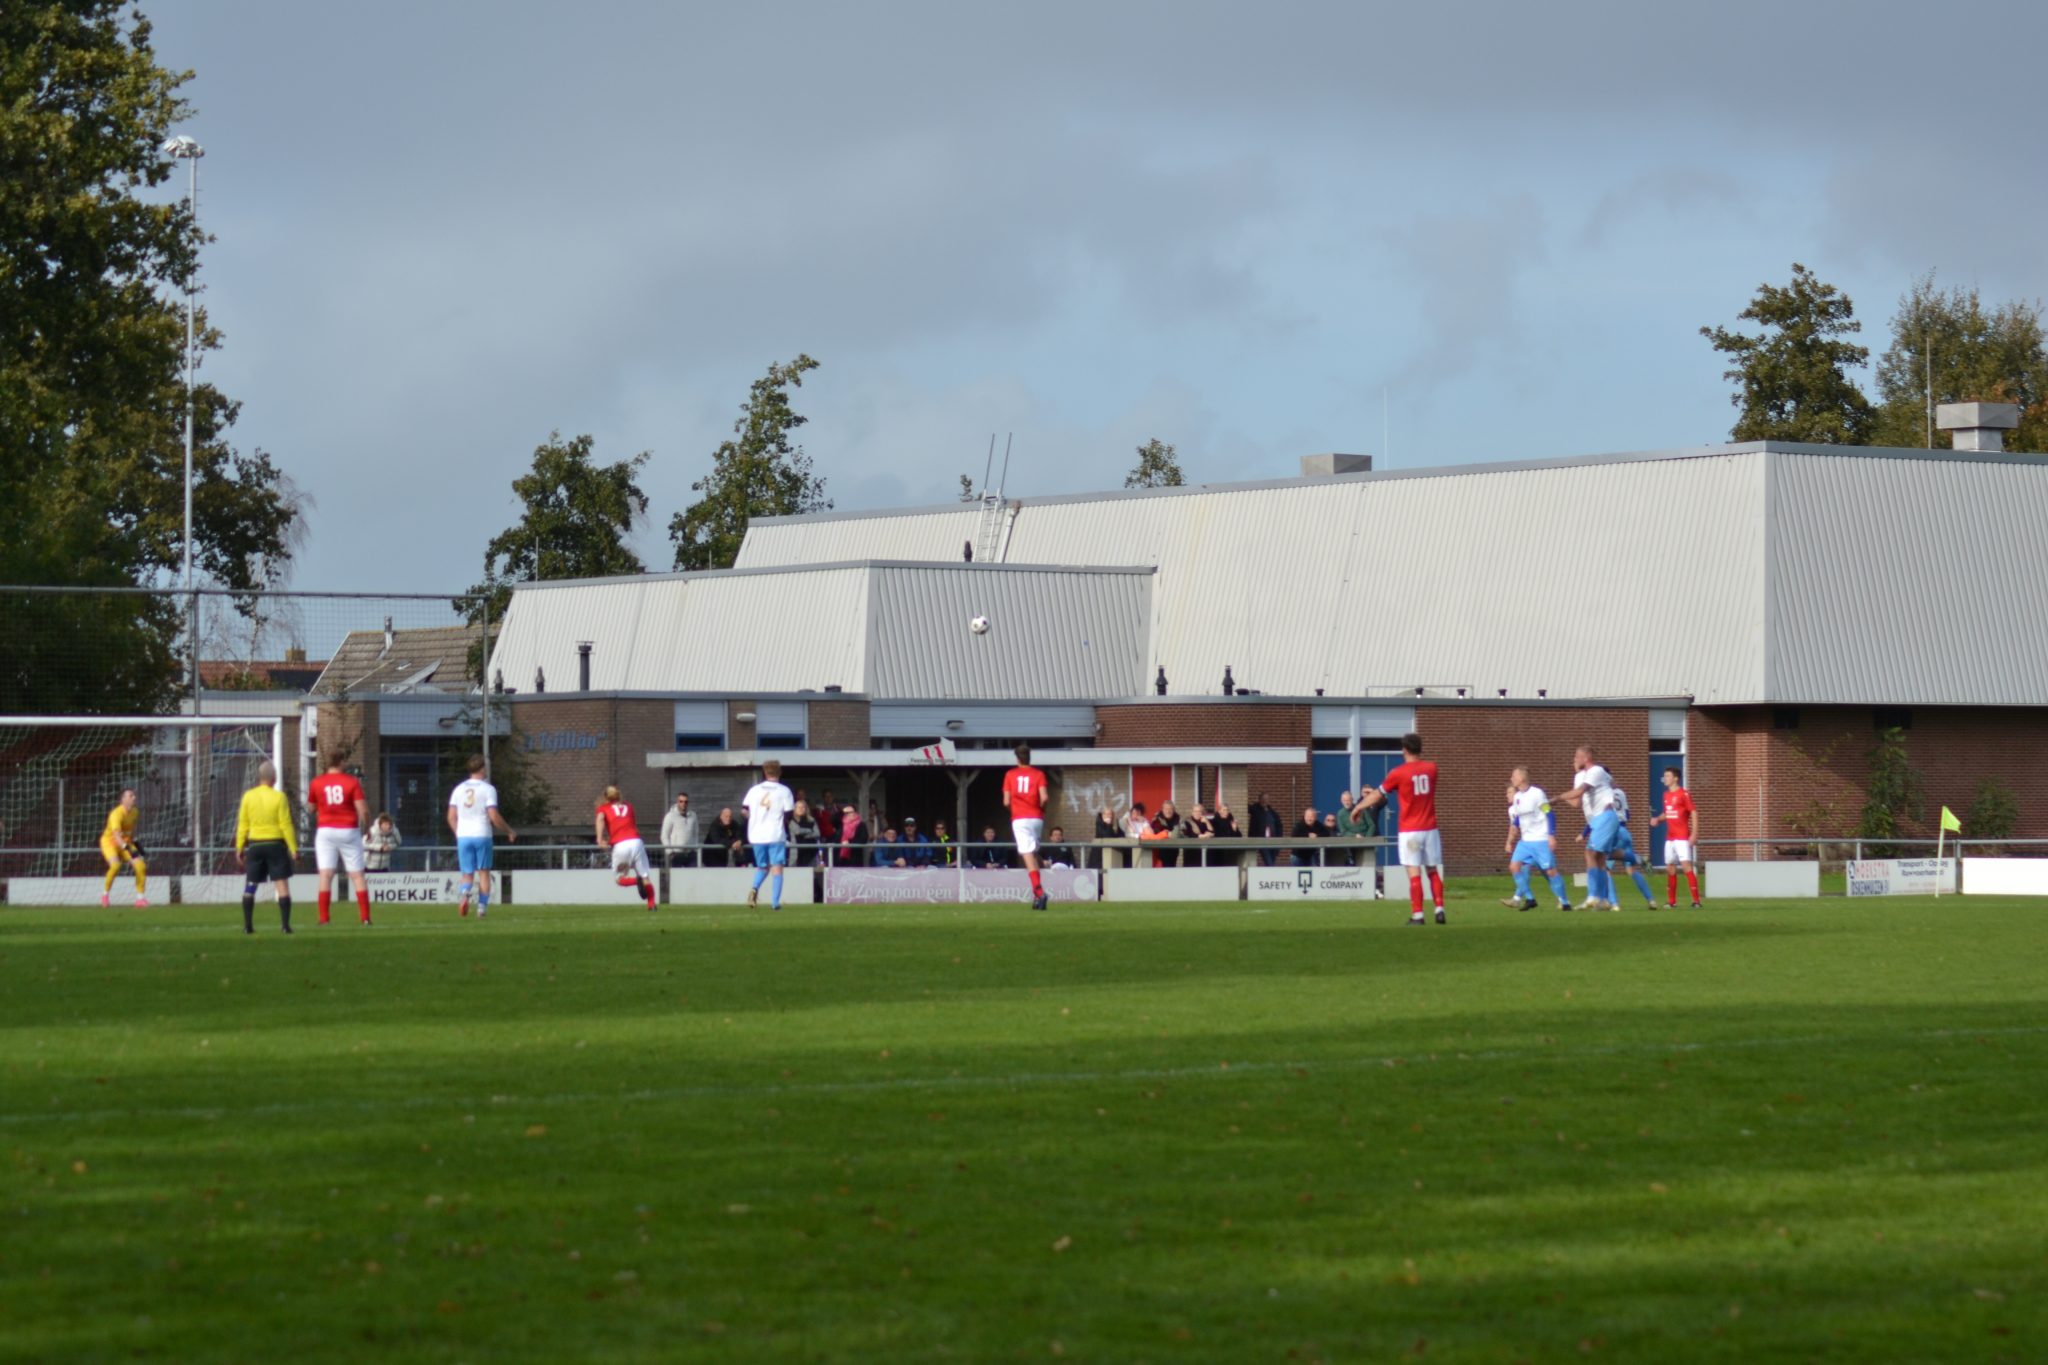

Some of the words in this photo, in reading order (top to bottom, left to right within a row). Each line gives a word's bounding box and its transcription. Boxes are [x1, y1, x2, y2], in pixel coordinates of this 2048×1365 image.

[1017, 775, 1030, 794] 11
[1411, 774, 1430, 796] 10
[324, 785, 344, 805] 18
[464, 788, 476, 808] 3
[760, 791, 772, 811] 4
[611, 804, 629, 818] 17
[374, 888, 438, 902] HOEKJE
[856, 882, 889, 903] Zorg
[892, 887, 920, 902] van
[1259, 881, 1293, 890] SAFETY
[1319, 880, 1364, 890] COMPANY
